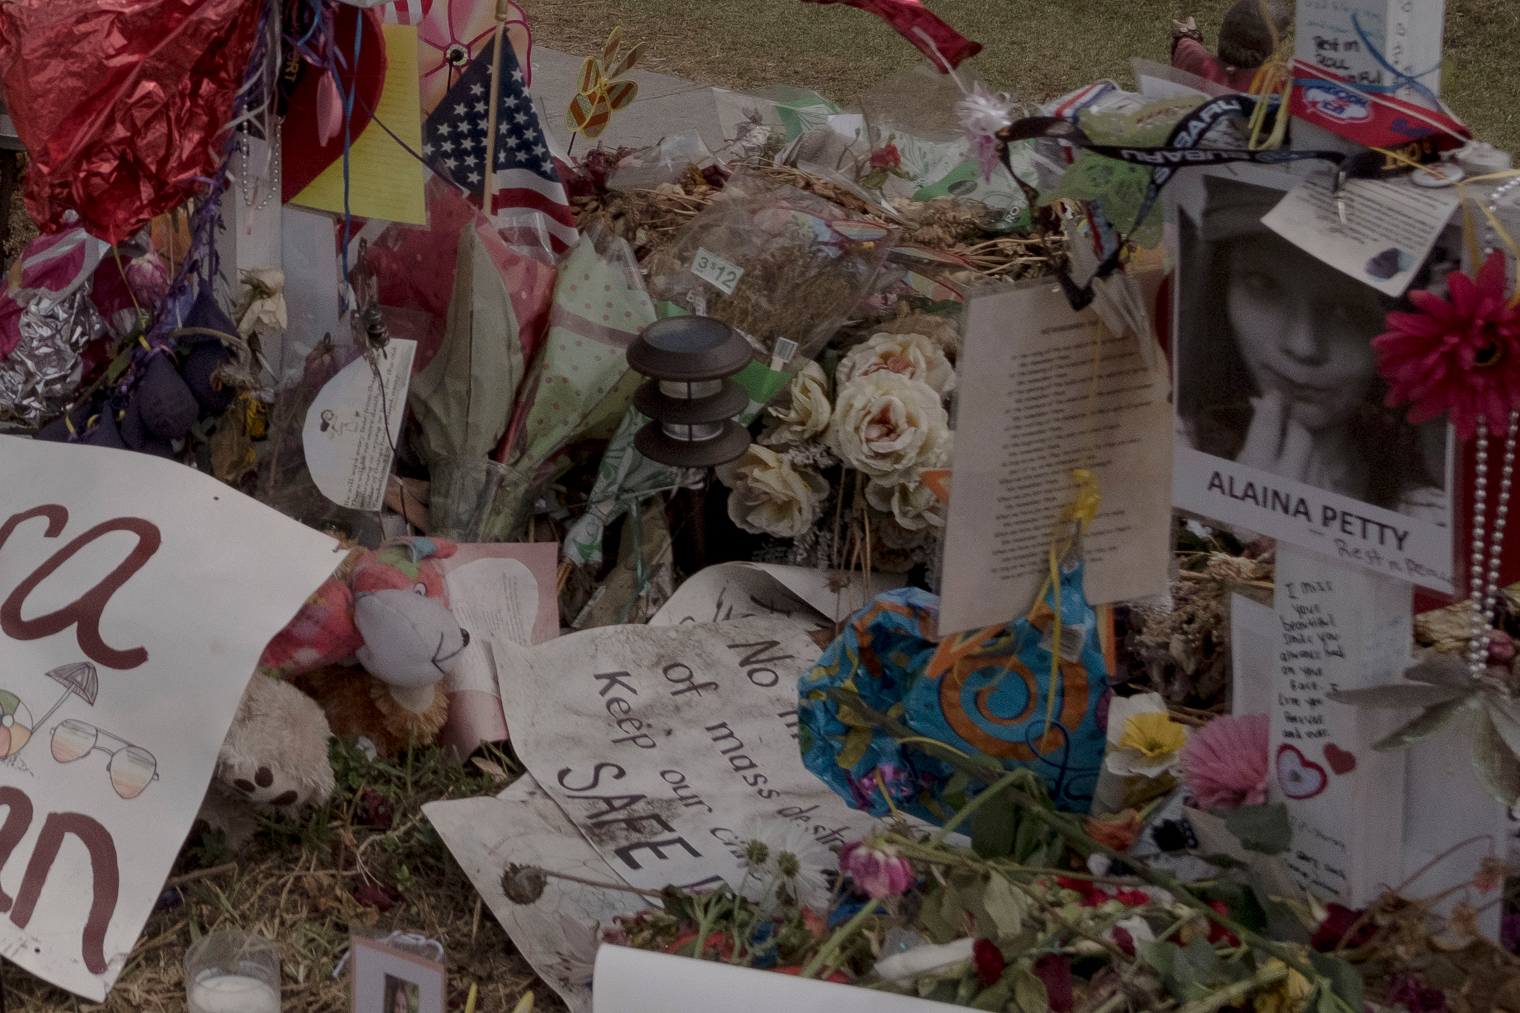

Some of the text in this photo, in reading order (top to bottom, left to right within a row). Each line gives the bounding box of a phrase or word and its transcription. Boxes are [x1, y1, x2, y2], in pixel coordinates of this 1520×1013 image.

[1121, 148, 1251, 164] SUBARU
[1207, 471, 1410, 551] ALAINA PETTY
[727, 639, 795, 688] No
[592, 669, 713, 813] Keep our
[662, 661, 719, 699] of
[704, 720, 781, 800] mass
[777, 805, 852, 845] destr
